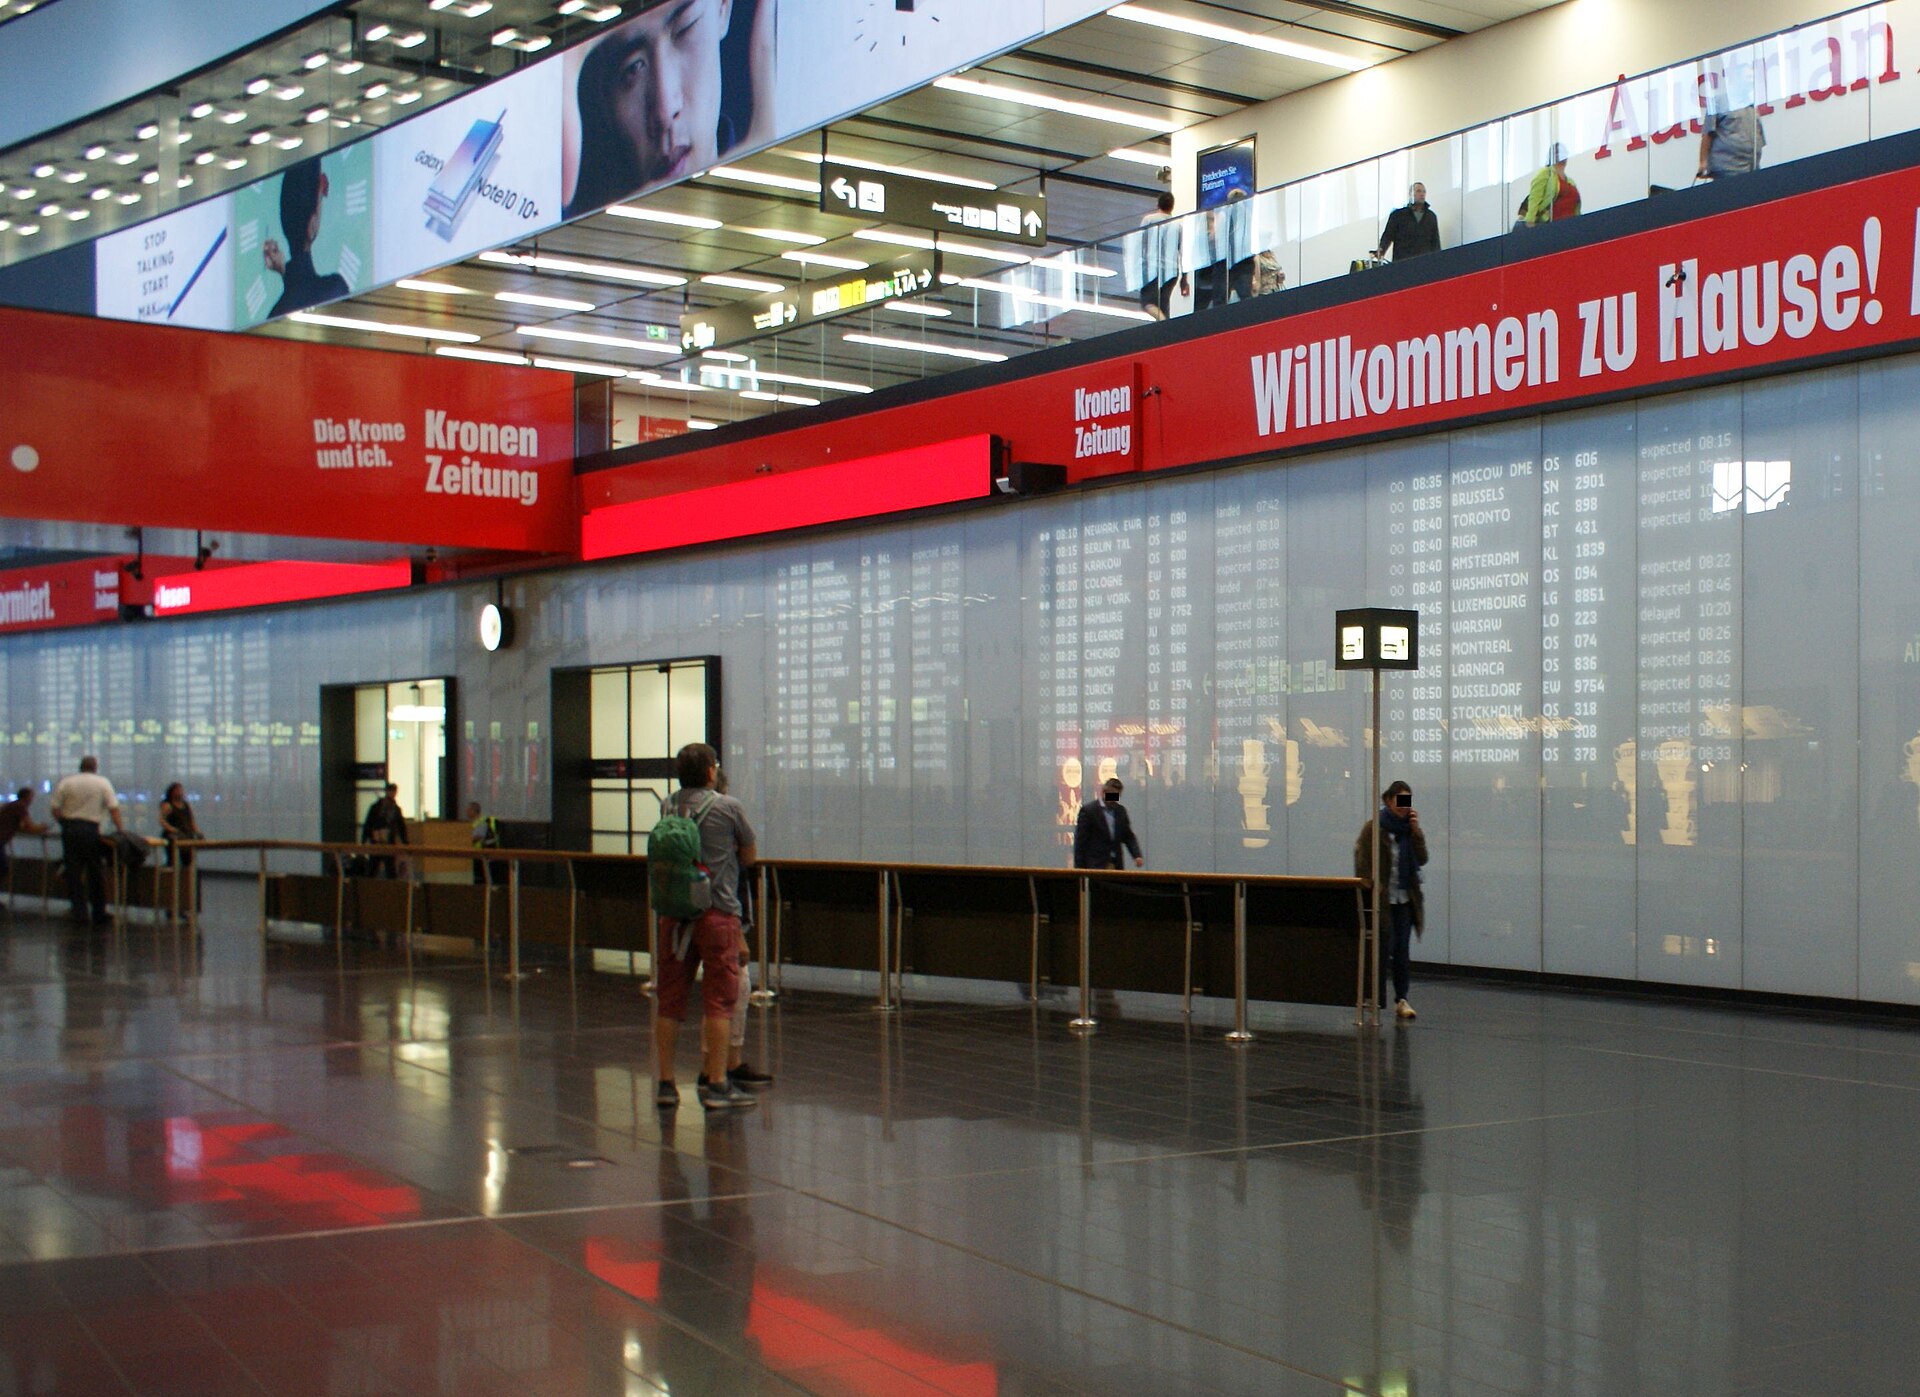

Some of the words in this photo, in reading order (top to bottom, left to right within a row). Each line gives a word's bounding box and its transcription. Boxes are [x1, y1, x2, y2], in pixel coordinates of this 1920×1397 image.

[1595, 22, 1900, 160] Ausrian
[144, 230, 166, 250] STOP
[137, 250, 174, 274] TALKING
[142, 275, 168, 296] START
[1251, 308, 1559, 436] Willkommen
[1579, 291, 1637, 377] zu
[1659, 216, 1883, 363] Hause!
[1075, 386, 1130, 421] Kronen
[313, 418, 346, 443] Die
[347, 418, 406, 443] Krone
[425, 409, 538, 457] Kronen
[1075, 423, 1130, 458] Zeitung
[316, 444, 354, 469] und
[357, 443, 393, 468] ich.
[1412, 475, 1443, 489] 08:35
[1452, 465, 1503, 486] MOSCOW
[1509, 461, 1533, 477] DME
[1543, 457, 1560, 472] OS
[1574, 452, 1598, 468] 606
[1640, 438, 1692, 460] expected
[425, 455, 538, 506] Zeitung
[1412, 497, 1443, 512] 08:35
[1452, 487, 1505, 507] BRUSSELS
[1543, 479, 1560, 494] SN
[1574, 474, 1605, 490] 2901
[1640, 462, 1692, 483] expected
[1412, 517, 1443, 531] 08:40
[1452, 508, 1512, 528] TORONTO
[1543, 502, 1560, 517] AC
[1574, 497, 1598, 513] 898
[1640, 486, 1692, 506] expected
[1412, 538, 1443, 552] 08:40
[1452, 534, 1478, 549] RIGA
[1543, 524, 1560, 539] BT
[1574, 520, 1598, 535] 431
[1640, 509, 1692, 529] expected
[1412, 559, 1443, 573] 08:40
[1452, 551, 1520, 570] AMSTERDAM
[1543, 547, 1560, 562] KL
[1574, 542, 1605, 558] 1839
[1412, 580, 1443, 595] 08:40
[1452, 572, 1530, 592] WASHINGTON
[1543, 568, 1560, 584] OS
[1574, 565, 1598, 580] 094
[1640, 557, 1692, 577] expected
[1452, 594, 1527, 613] LUXEMBOURG
[1543, 591, 1560, 606] LG
[1574, 588, 1605, 603] 8851
[1640, 581, 1692, 600] expected
[1418, 622, 1443, 637] 8:45
[1452, 618, 1503, 634] WARSAW
[1543, 613, 1560, 629] LO
[1574, 611, 1598, 626] 223
[1640, 605, 1682, 622] delayed
[1418, 643, 1443, 658] 8:45
[1452, 639, 1513, 656] MONTREAL
[1543, 636, 1560, 651] OS
[1574, 633, 1598, 648] 074
[1640, 629, 1692, 647] expected
[1452, 662, 1505, 677] LARNACA
[1543, 658, 1560, 673] OS
[1574, 657, 1598, 671] 836
[1640, 652, 1692, 670] expected
[1412, 686, 1443, 701] 08:50
[1452, 682, 1523, 698] DUSSELDORF
[1543, 680, 1561, 695] EW
[1574, 679, 1605, 694] 9754
[1640, 676, 1692, 693] expected
[1412, 707, 1443, 722] 08:50
[1452, 704, 1523, 720] STOCKHOLM
[1543, 703, 1560, 718] OS
[1574, 702, 1598, 717] 318
[1640, 700, 1692, 716] expected
[1412, 728, 1443, 743] 08:55
[1640, 723, 1692, 739] expected
[1412, 750, 1443, 764] 08:55
[1452, 749, 1520, 763] AMSTERDAM
[1543, 747, 1560, 762] OS
[1574, 747, 1598, 762] 378
[1640, 747, 1692, 762] expected
